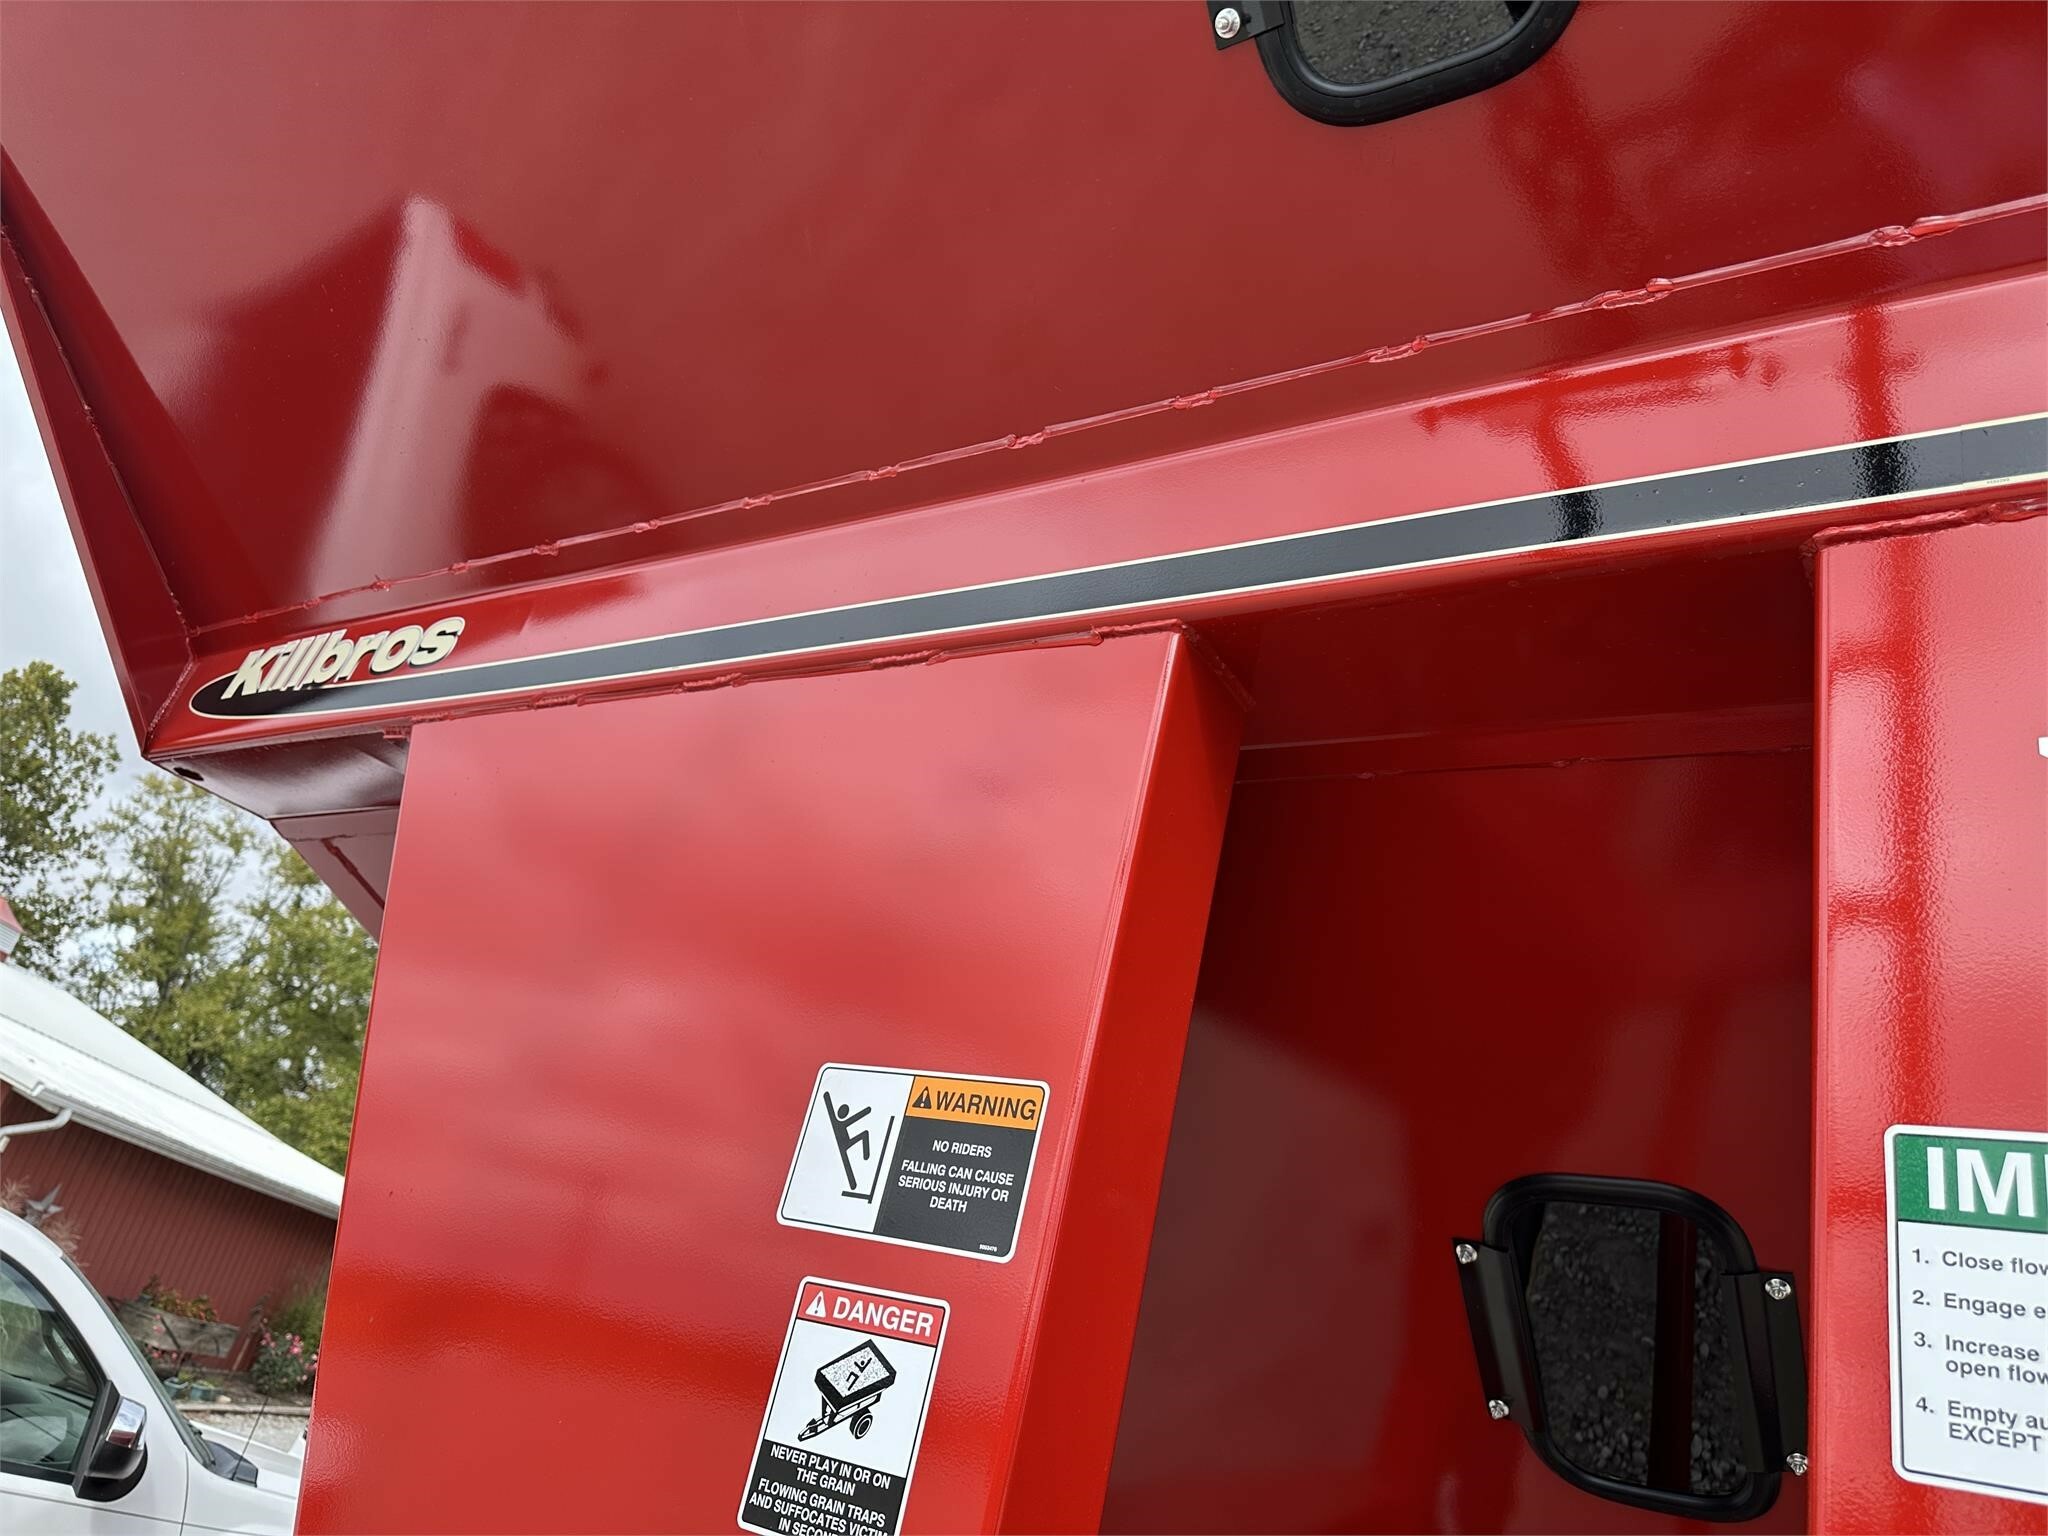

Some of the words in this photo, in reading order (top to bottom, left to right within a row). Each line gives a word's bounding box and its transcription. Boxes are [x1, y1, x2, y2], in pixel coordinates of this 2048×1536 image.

[220, 616, 466, 700] Killbros
[936, 1090, 1037, 1121] WARNING
[932, 1140, 949, 1153] NO
[951, 1143, 992, 1158] RIDERS
[901, 1160, 947, 1176] FALLING
[948, 1165, 973, 1180] CAN
[974, 1169, 1014, 1186] CAUSE
[1927, 1146, 2048, 1218] IM
[898, 1175, 946, 1193] SERIOUS
[948, 1182, 990, 1199] INJURY
[991, 1189, 1009, 1202] OR
[929, 1196, 967, 1213] DEATH
[1912, 1248, 1930, 1264] 1.
[1942, 1251, 2004, 1272] Close
[833, 1296, 934, 1337] DANGER
[1912, 1289, 1931, 1306] 2.
[1944, 1292, 2026, 1319] Engage
[1913, 1331, 1932, 1348] 3.
[1945, 1334, 2040, 1362] Increase
[1945, 1359, 2000, 1378] open
[1915, 1397, 1934, 1414] 4.
[1948, 1399, 2018, 1429] Empty
[1949, 1422, 2042, 1452] EXCEPT
[770, 1444, 807, 1466] NEVER
[808, 1455, 839, 1473] PLAY
[839, 1463, 852, 1478] IN
[853, 1467, 871, 1483] OR
[872, 1472, 891, 1490] ON
[796, 1468, 819, 1485] THE
[819, 1475, 856, 1497] GRAIN
[749, 1492, 773, 1510] AND
[773, 1499, 847, 1533] SUFFOCATES
[758, 1478, 808, 1504] FLOWING
[809, 1493, 846, 1515] GRAIN
[848, 1504, 886, 1528] TRAPS
[778, 1517, 791, 1533] IN
